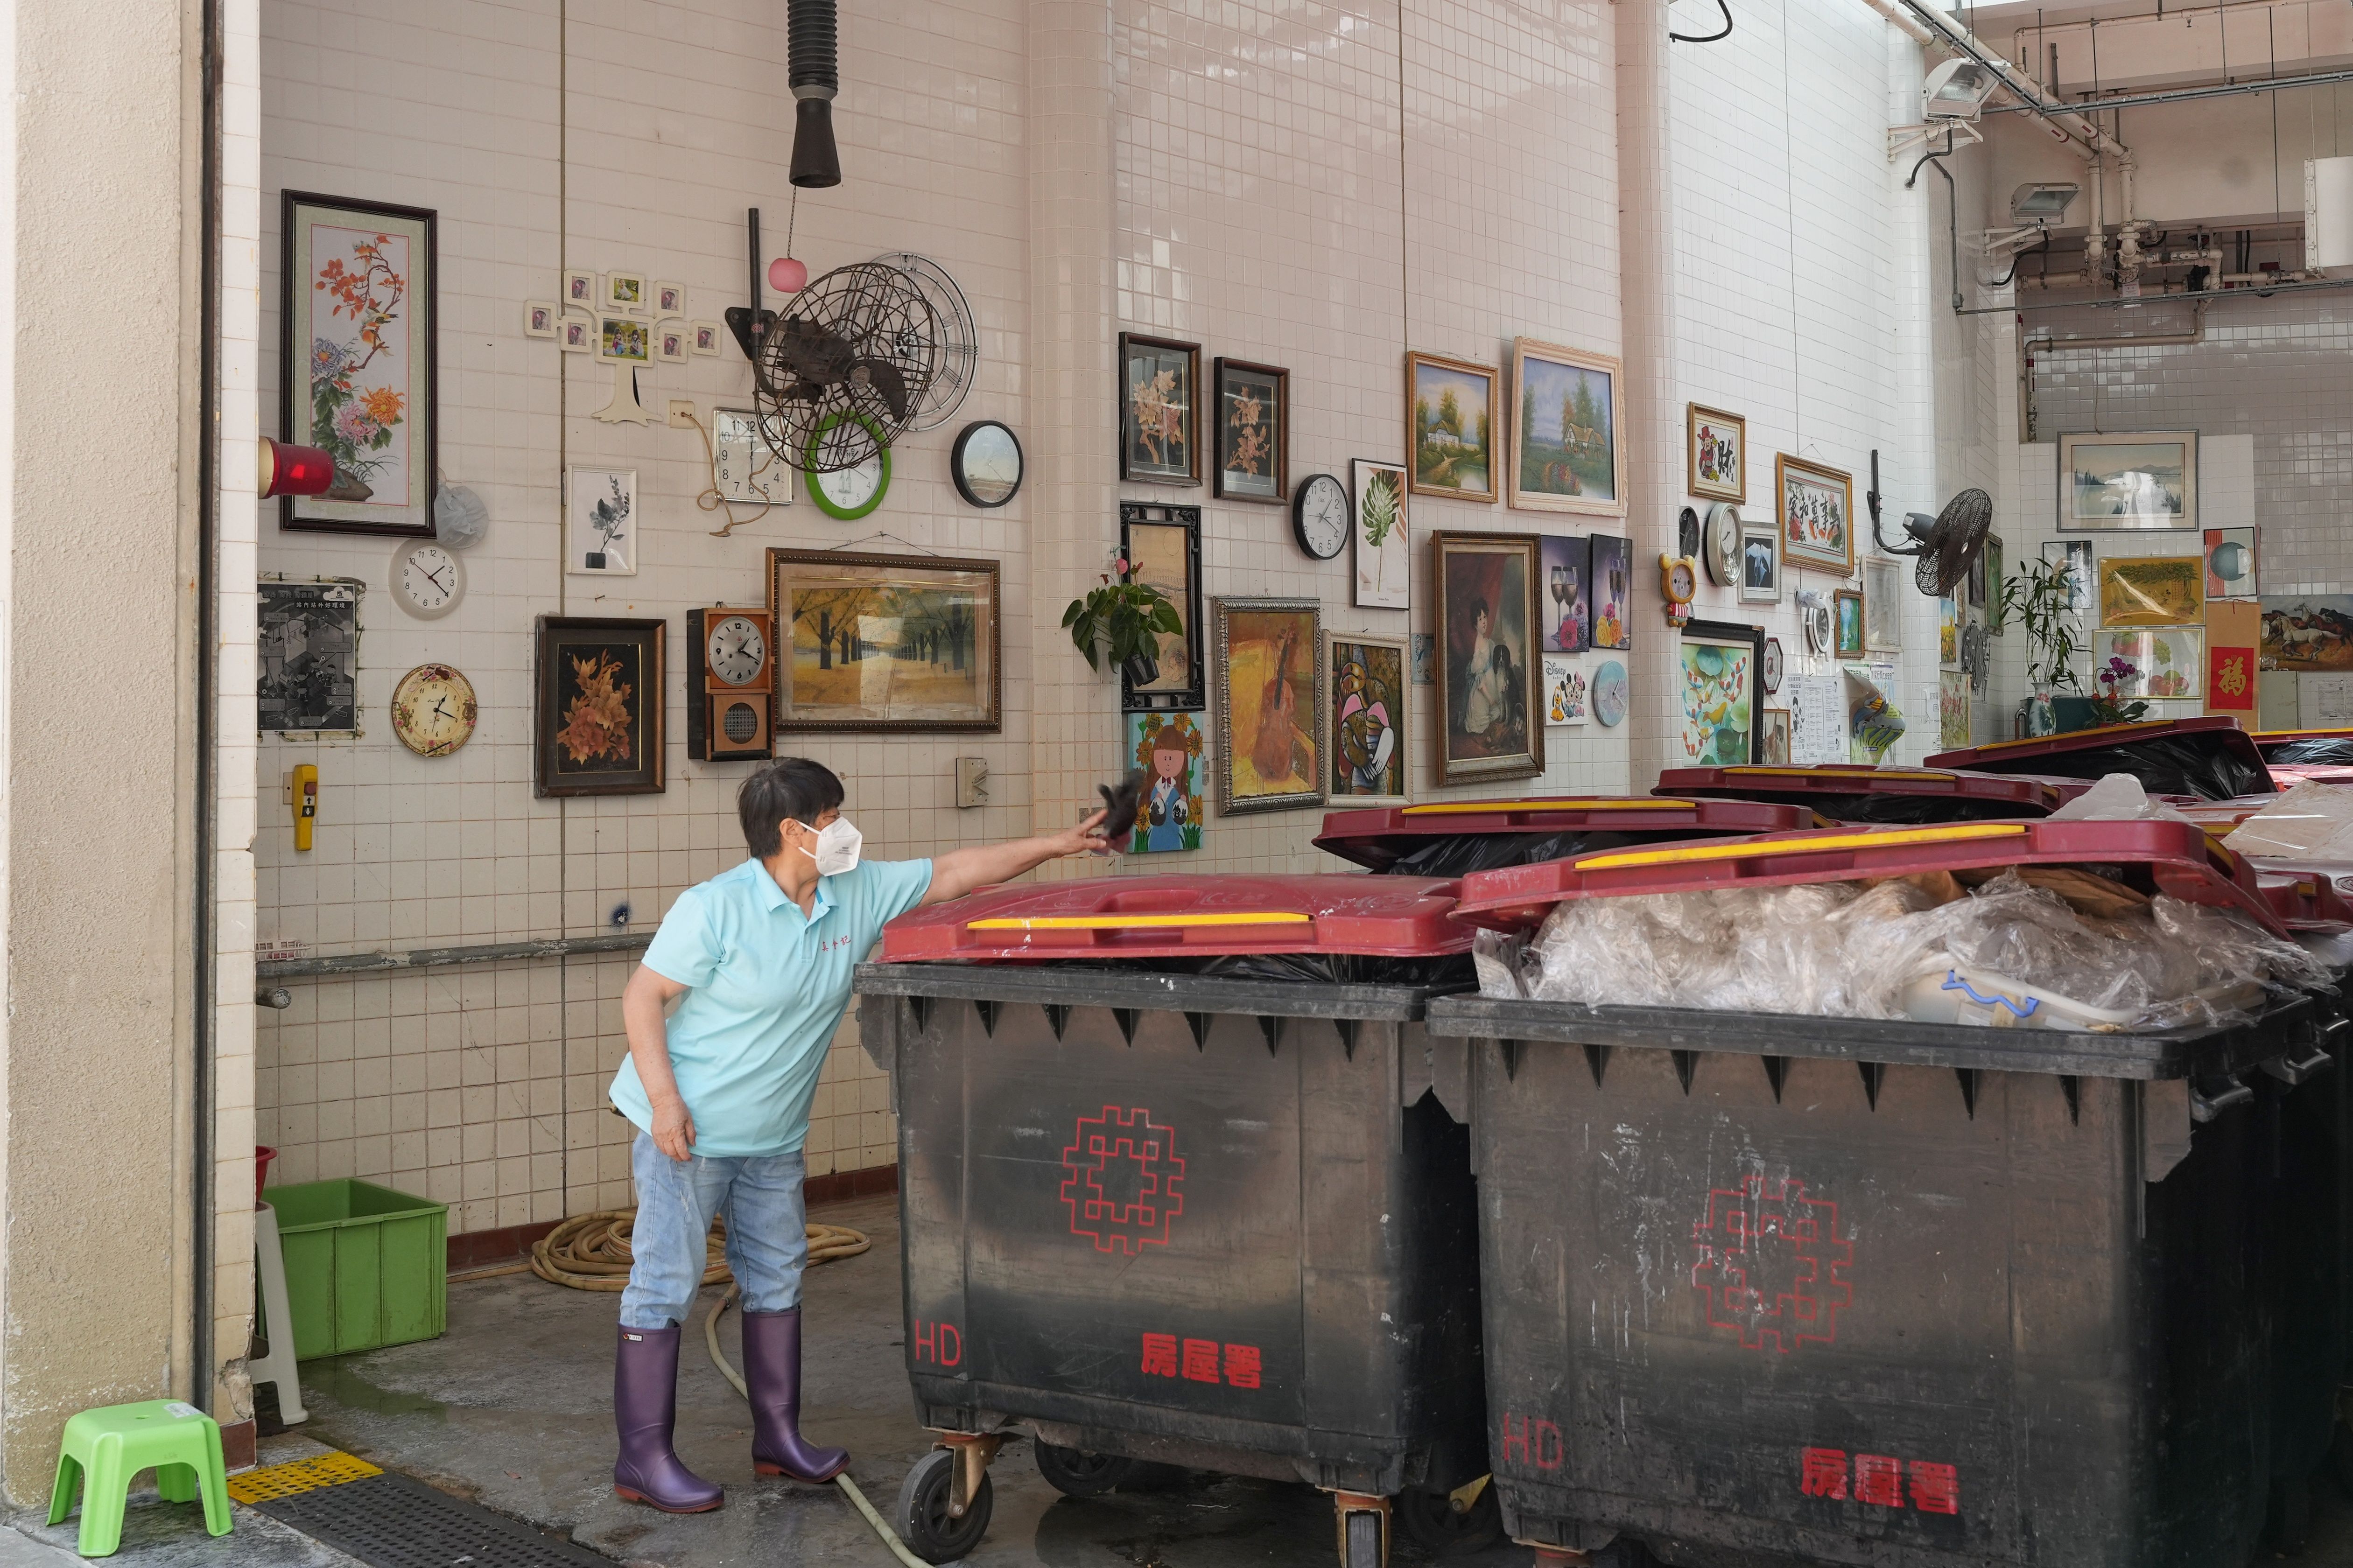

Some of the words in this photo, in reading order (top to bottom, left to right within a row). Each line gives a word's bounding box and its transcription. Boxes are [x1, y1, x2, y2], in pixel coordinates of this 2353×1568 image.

[732, 420, 739, 431] 11
[746, 421, 755, 431] 12
[721, 431, 730, 442] 10
[722, 450, 728, 460] 9
[1718, 438, 1733, 478] 財
[723, 469, 729, 479] 8
[773, 473, 780, 483] 4
[734, 482, 740, 492] 7
[748, 484, 754, 494] 6
[763, 484, 769, 494] 5
[1311, 484, 1317, 494] 11
[1319, 482, 1326, 492] 12
[1330, 488, 1332, 497] 1
[1335, 499, 1339, 509] 2
[1337, 514, 1342, 525] 3
[1334, 531, 1339, 540] 4
[1310, 537, 1314, 547] 7
[1328, 539, 1331, 550] 5
[1319, 542, 1322, 553] 6
[2218, 656, 2246, 697] 福
[915, 1318, 961, 1366] HD
[1141, 1332, 1262, 1389] 房屋署
[1503, 1411, 1563, 1470] HD
[1801, 1447, 1959, 1514] 房屋署
